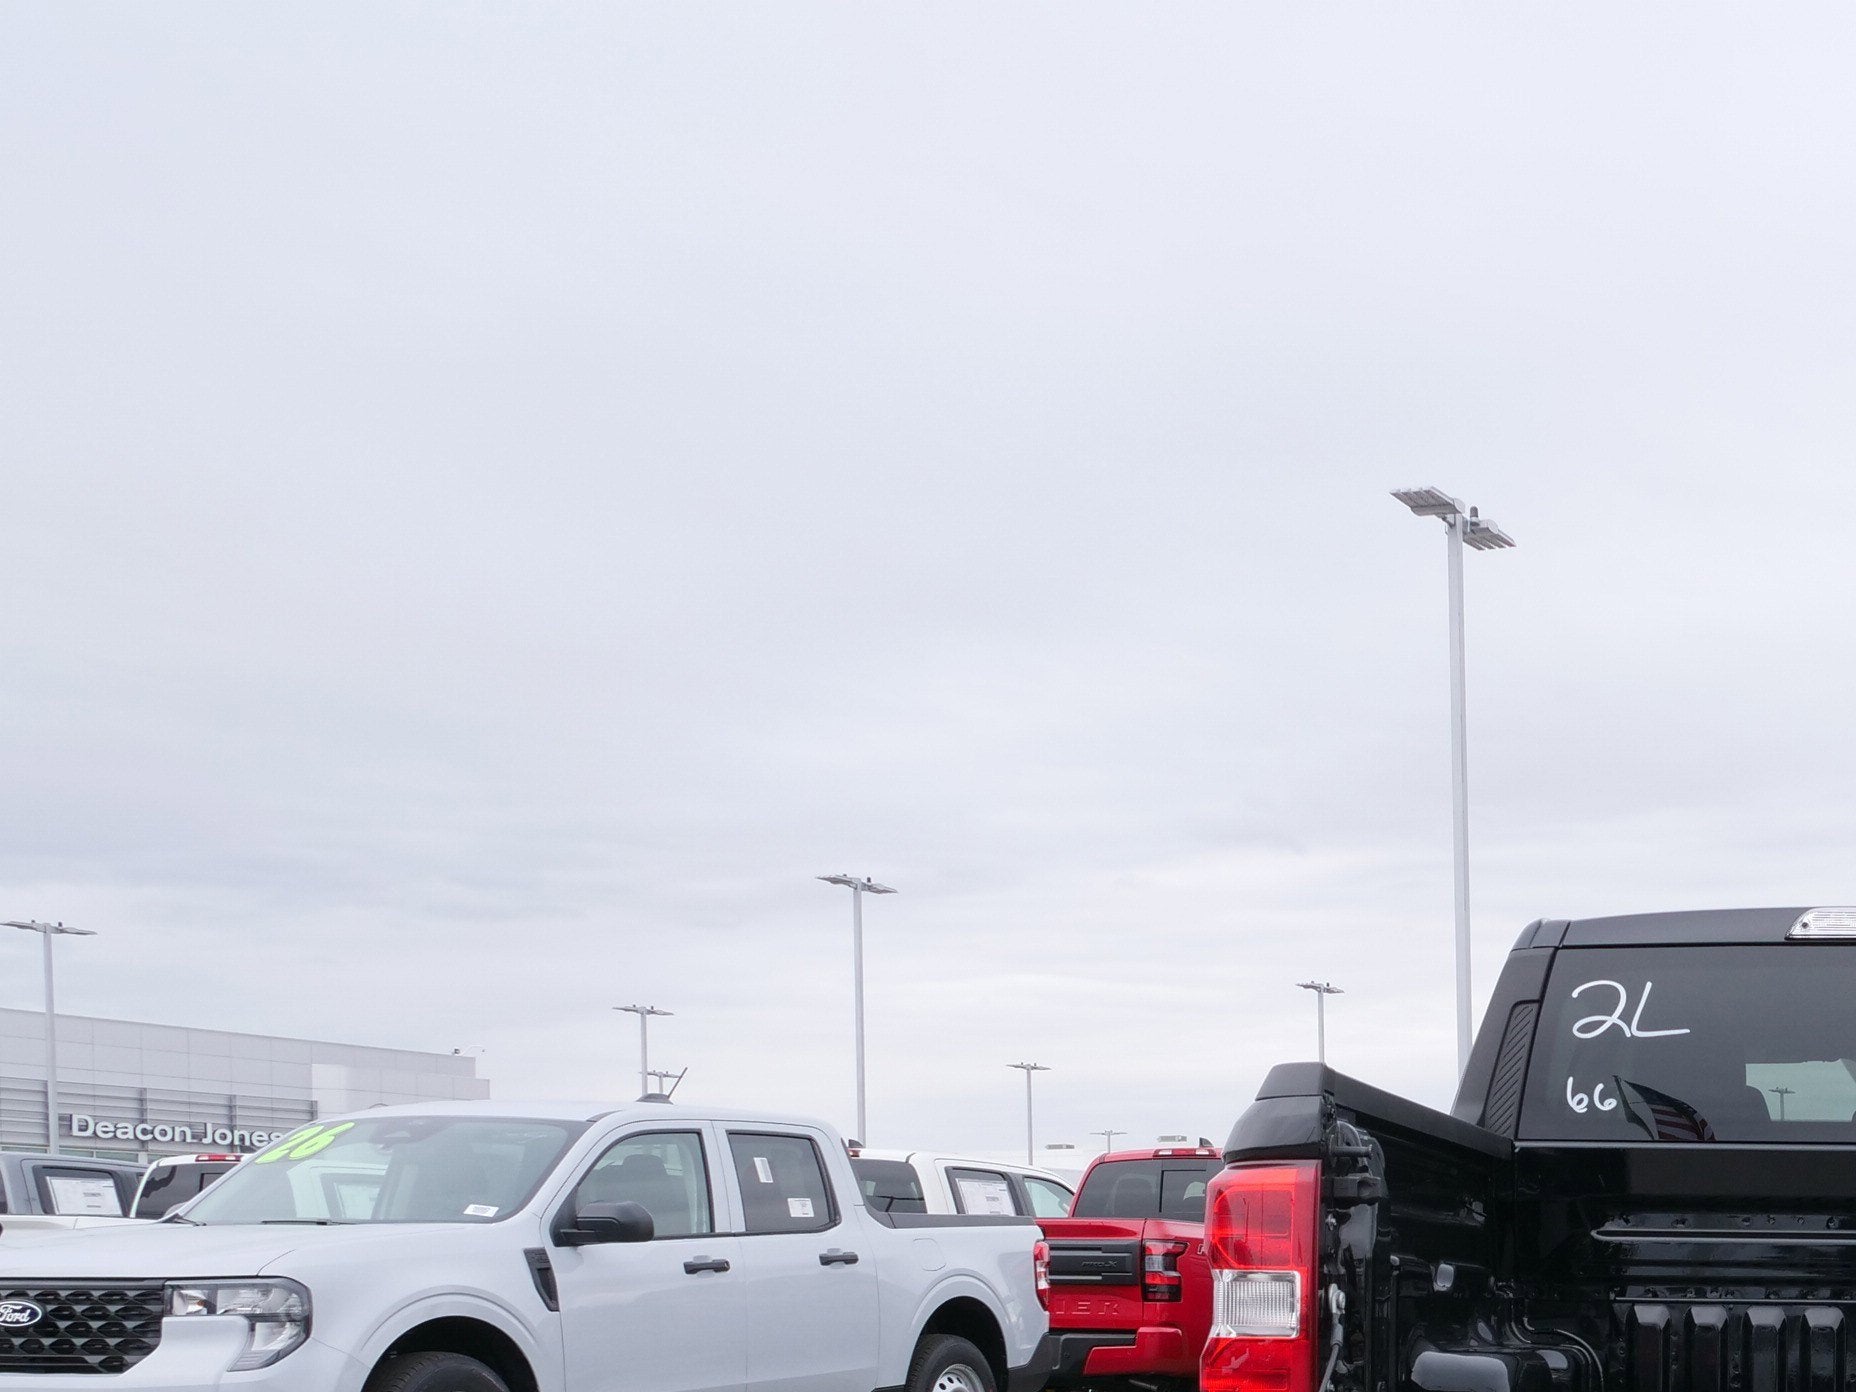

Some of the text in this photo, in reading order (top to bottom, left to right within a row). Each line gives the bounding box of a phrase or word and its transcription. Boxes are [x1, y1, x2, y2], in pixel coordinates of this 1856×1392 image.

[1571, 980, 1691, 1039] 2L
[1566, 1076, 1618, 1114] 66
[70, 1114, 192, 1143] Deacon
[255, 1121, 355, 1165] 26
[0, 1304, 31, 1323] Ford
